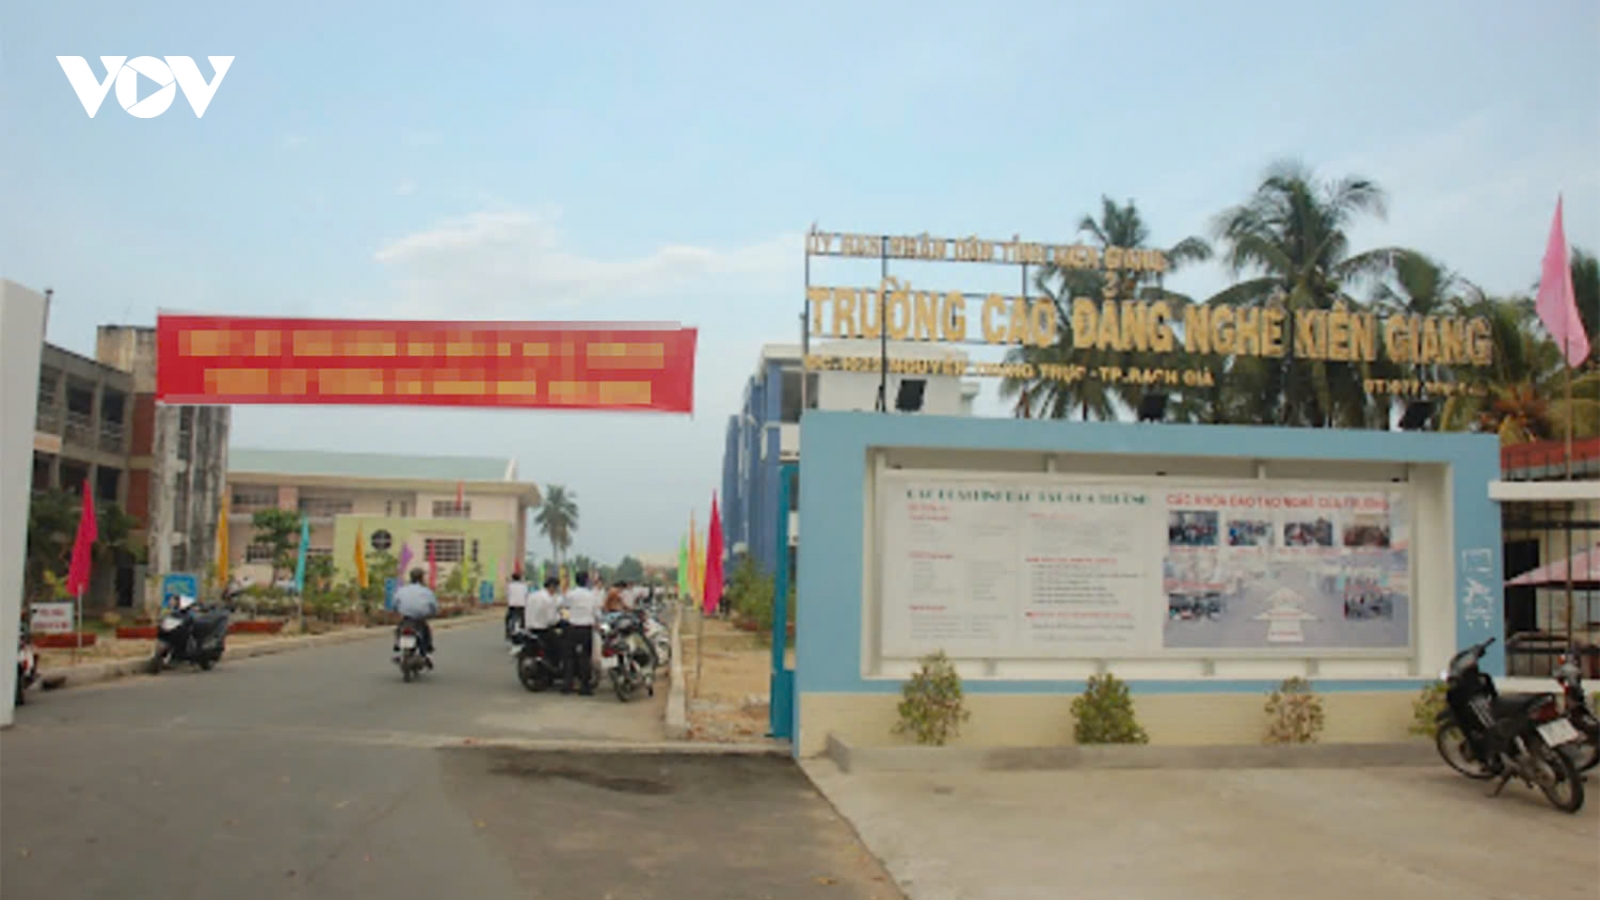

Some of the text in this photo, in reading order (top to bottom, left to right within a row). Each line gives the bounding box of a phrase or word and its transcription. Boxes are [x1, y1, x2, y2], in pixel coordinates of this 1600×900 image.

[807, 276, 967, 341] TRƯỜNG
[981, 294, 1057, 348] CAO
[1072, 271, 1174, 353] ĐẲNG
[1295, 299, 1377, 362] KIÊN
[1384, 312, 1493, 365] GIANG
